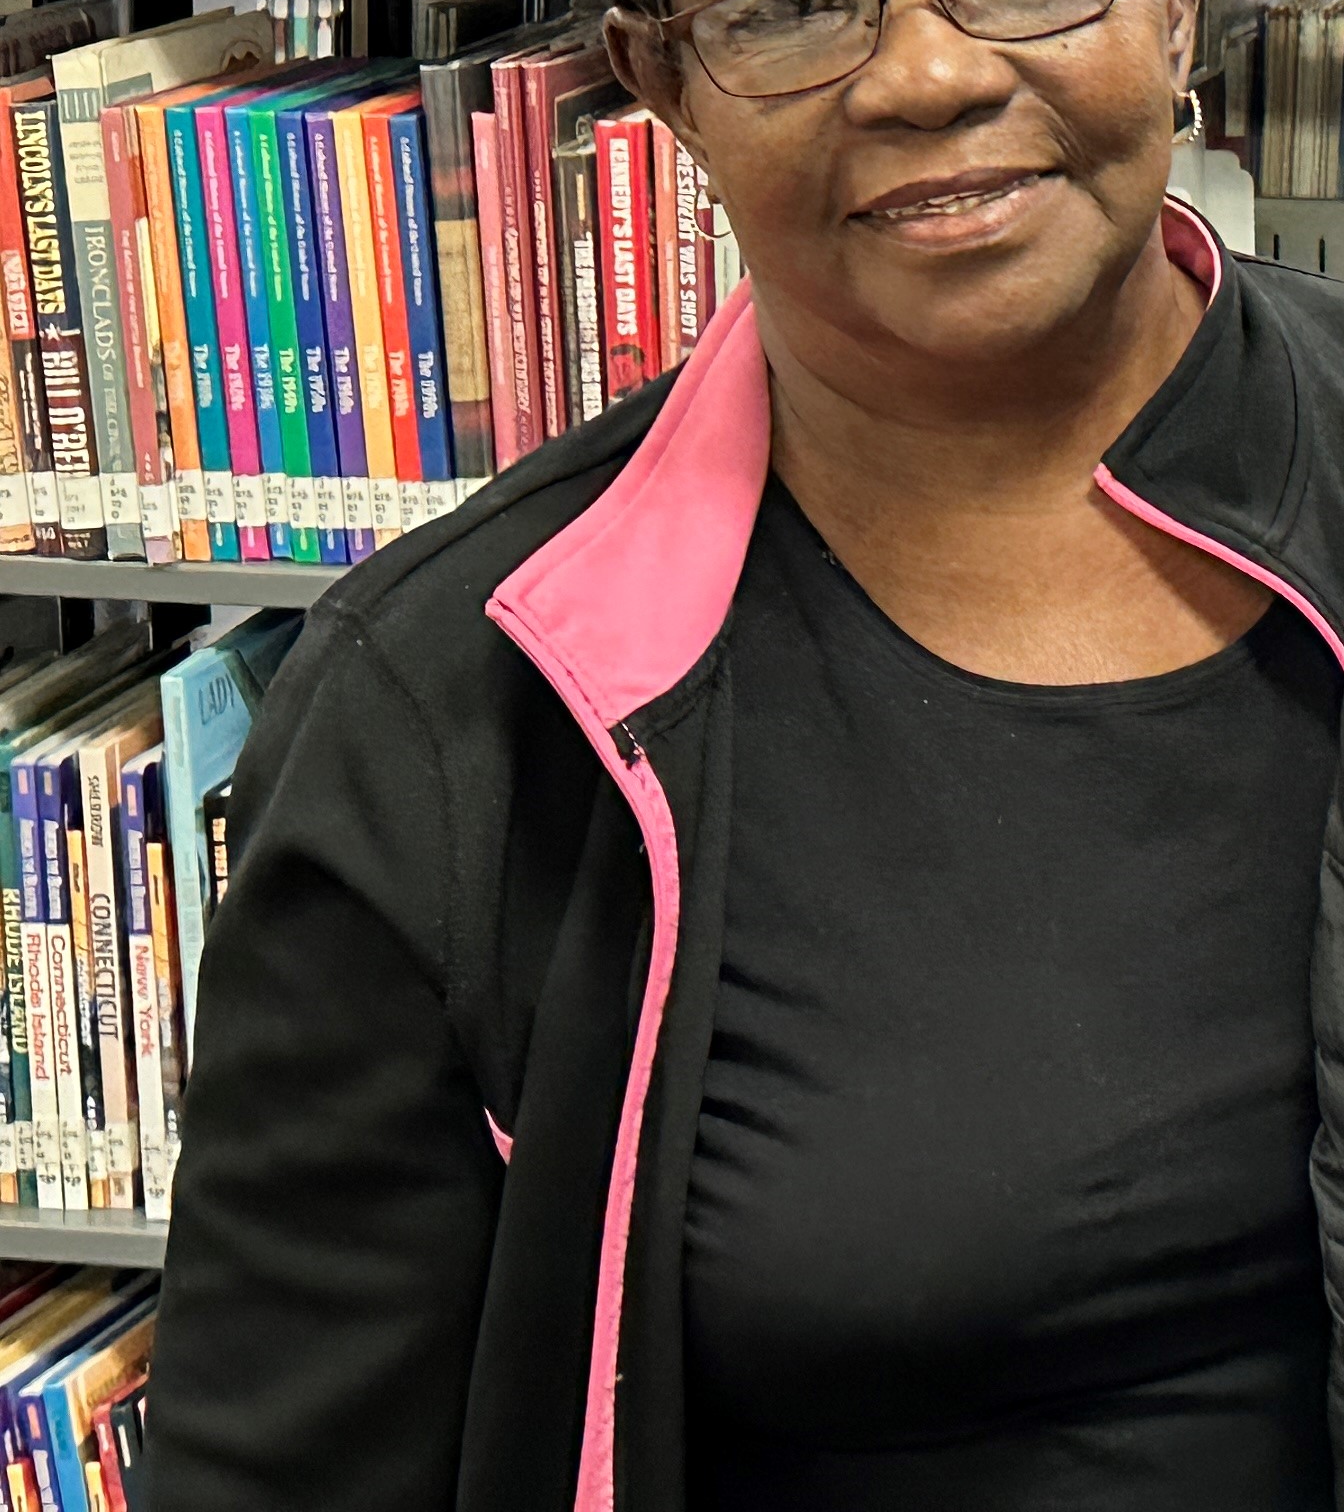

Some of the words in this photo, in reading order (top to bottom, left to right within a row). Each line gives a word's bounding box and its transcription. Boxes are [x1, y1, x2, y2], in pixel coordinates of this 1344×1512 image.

[12, 110, 52, 213] LINCOLN'S
[608, 137, 634, 244] KENNEDY'S
[675, 138, 696, 242] RESIDENT
[29, 213, 61, 264] LAST
[611, 244, 637, 287] LAST
[678, 245, 697, 286] WAS
[34, 264, 67, 316] DAYS
[84, 225, 117, 361] IRONCLADS
[615, 287, 639, 337] DAYS
[680, 289, 698, 338] SHOT
[43, 350, 80, 399] BILL
[51, 405, 94, 478] O'REI
[4, 888, 25, 968] RHODE
[26, 932, 41, 1009] Rhode
[90, 892, 118, 1039] CONNECTICUT
[134, 943, 151, 1001] New
[7, 972, 28, 1054] ISLAND
[51, 934, 71, 1076] Connecticut
[138, 1004, 157, 1058] York
[31, 1013, 49, 1081] Island
